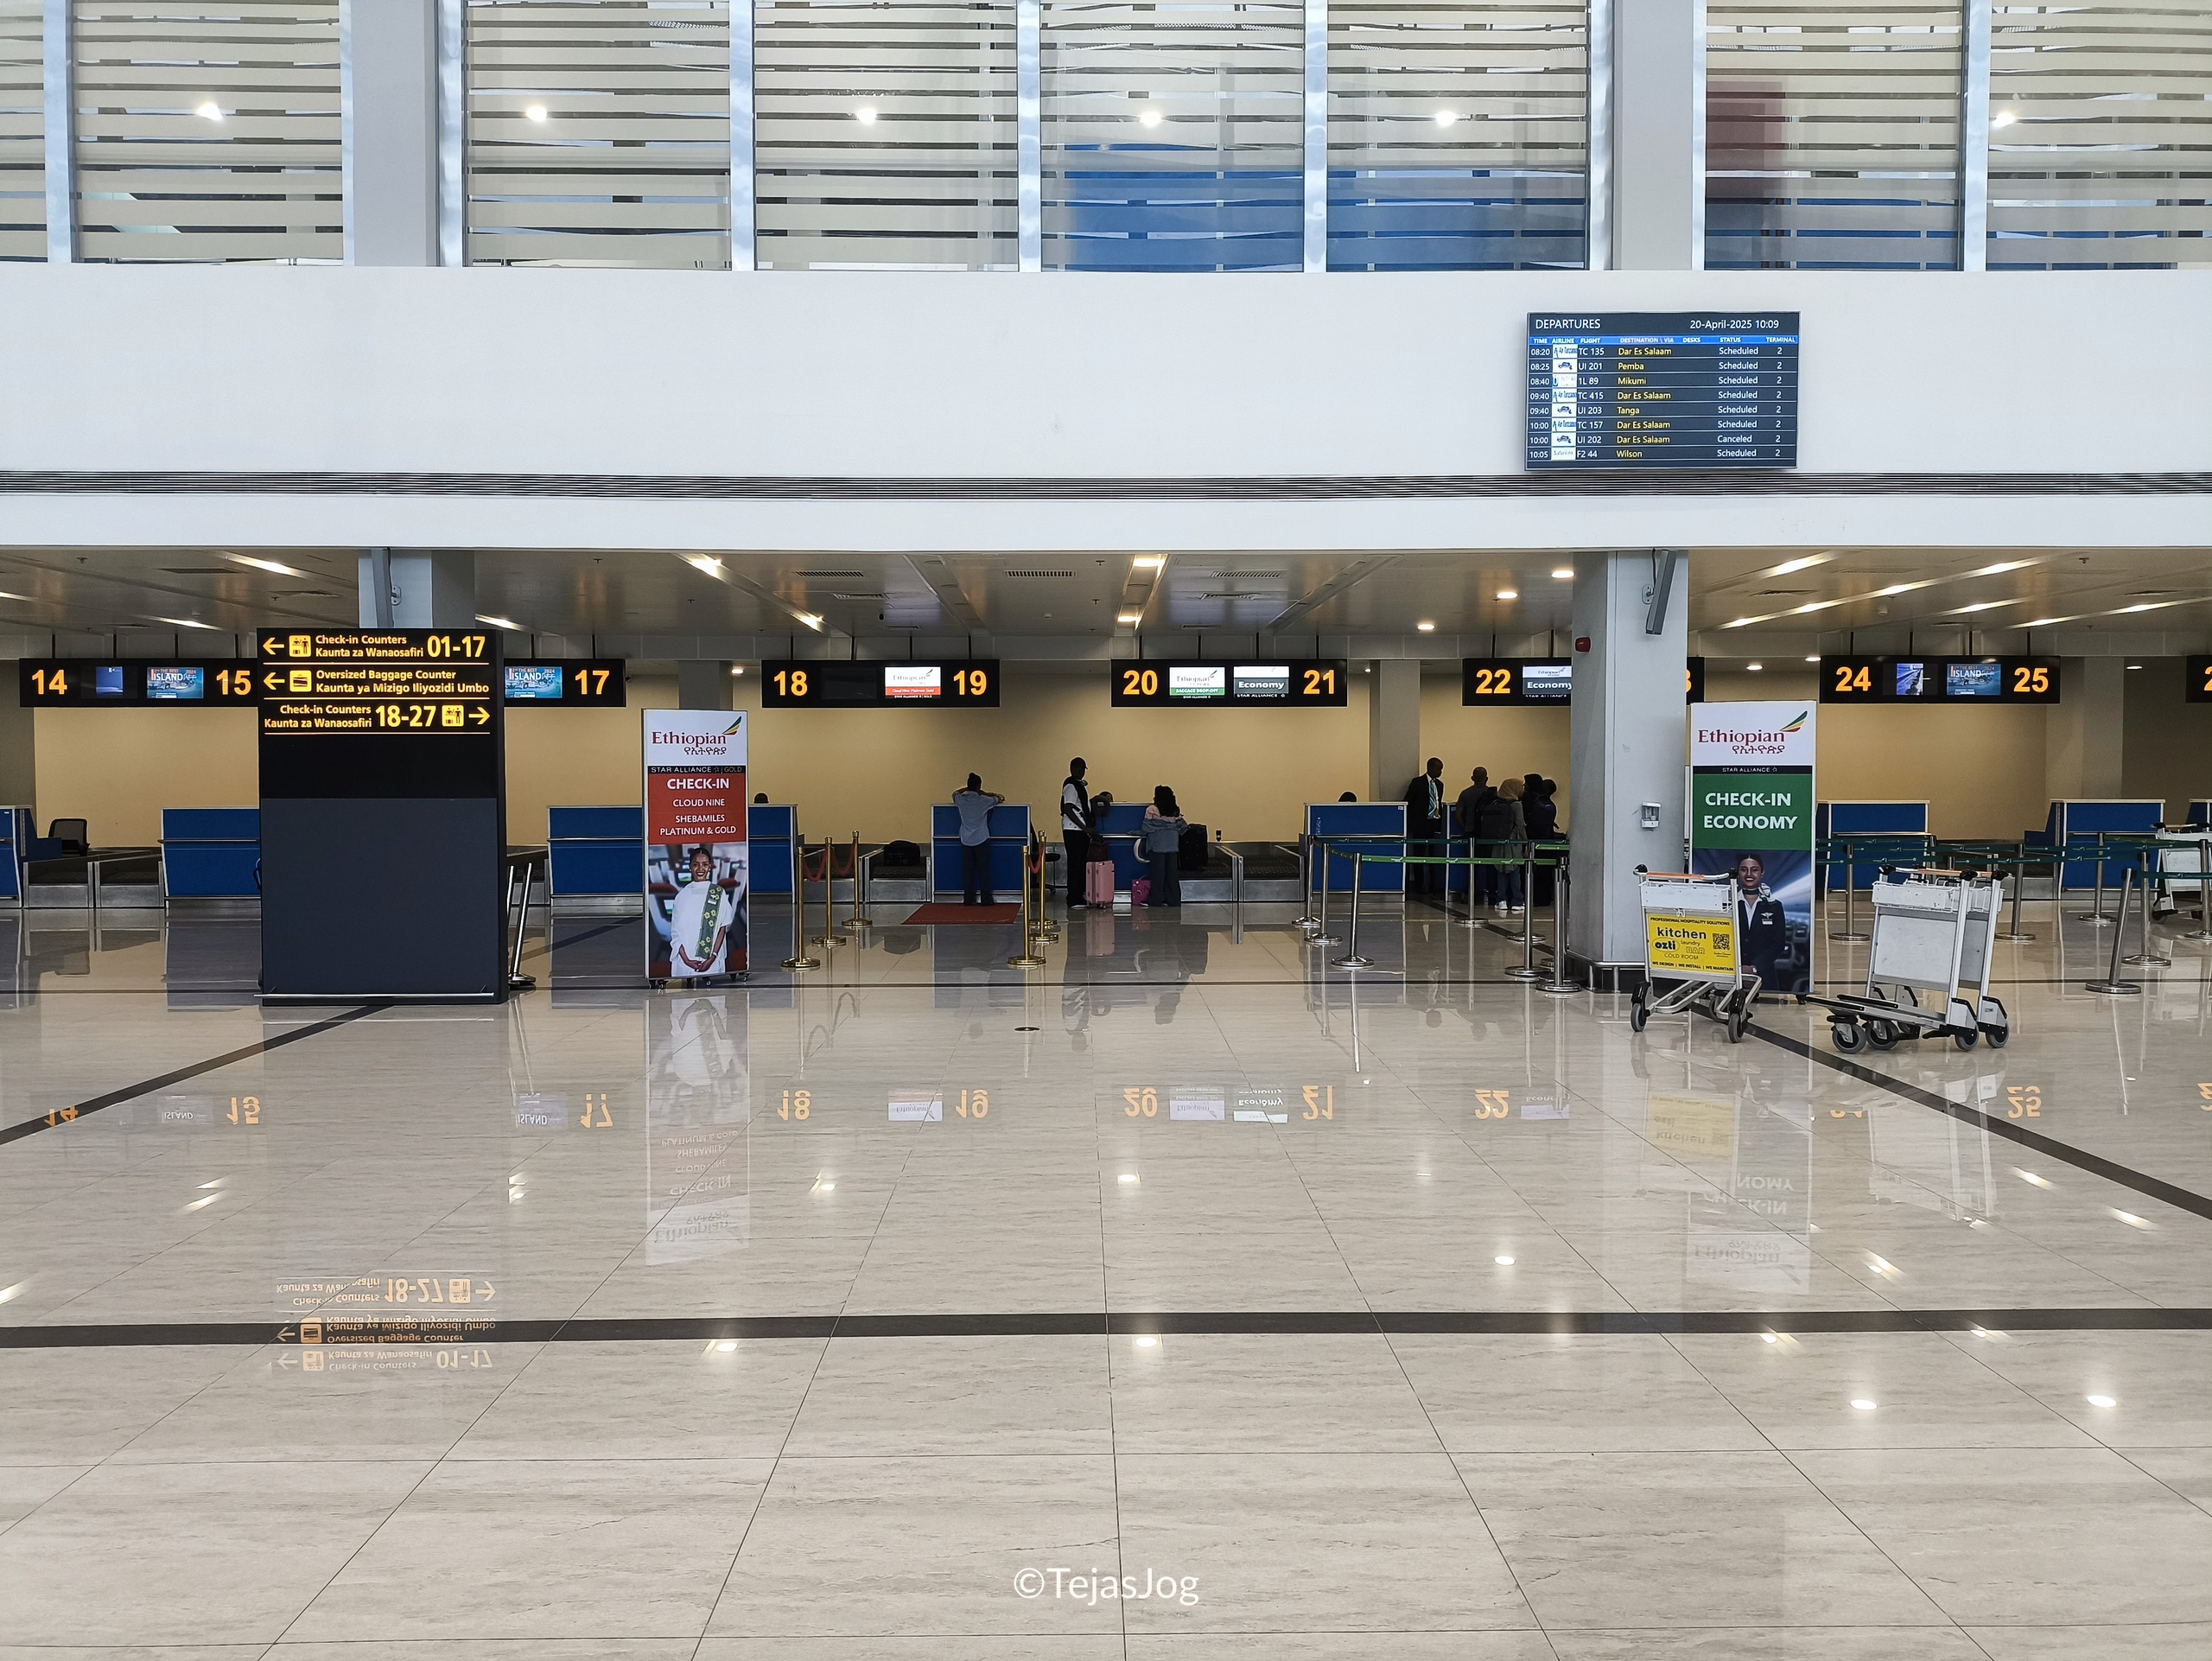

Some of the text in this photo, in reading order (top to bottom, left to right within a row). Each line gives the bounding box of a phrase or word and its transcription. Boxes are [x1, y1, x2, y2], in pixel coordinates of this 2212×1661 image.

[1536, 319, 1600, 328] DEPARTURES
[1690, 320, 1779, 330] 20-April-2025 10:09
[1618, 407, 1639, 416] Tanga
[315, 635, 406, 644] Check-in Counters
[315, 648, 350, 657] Kaunta
[365, 648, 423, 657] Wanaosafiri
[427, 635, 485, 658] 01-17
[31, 669, 67, 695] 14
[216, 670, 251, 695] 15
[316, 671, 456, 681] Oversized Baggage Counter
[575, 670, 609, 695] 17
[953, 670, 987, 695] 19
[1303, 670, 1334, 694] 21
[1476, 669, 1510, 694] 22
[1835, 666, 1872, 691] 24
[2014, 667, 2049, 692] 25
[316, 684, 489, 695] Kaunta ya Mizigo Iliyozidi Umbo
[774, 671, 808, 696] 18
[1123, 670, 1158, 696] 20
[1238, 681, 1284, 690] Economy
[280, 705, 322, 714] Check-in
[375, 705, 436, 727] 18-27
[264, 719, 298, 728] Kaunta
[315, 718, 372, 728] Wanaosafiri
[652, 731, 726, 748] Ethiopian
[1699, 729, 1784, 746] Ethiopian
[667, 778, 729, 790] CHECK-IN
[673, 799, 704, 807] CLOUD
[1705, 792, 1791, 805] CHECK-IN
[676, 814, 725, 823] SHEBAMILES
[1704, 816, 1797, 829] ECONOMY
[660, 827, 705, 836] PLATINUM
[1657, 926, 1707, 939] kitchen
[1655, 940, 1675, 950] ozti
